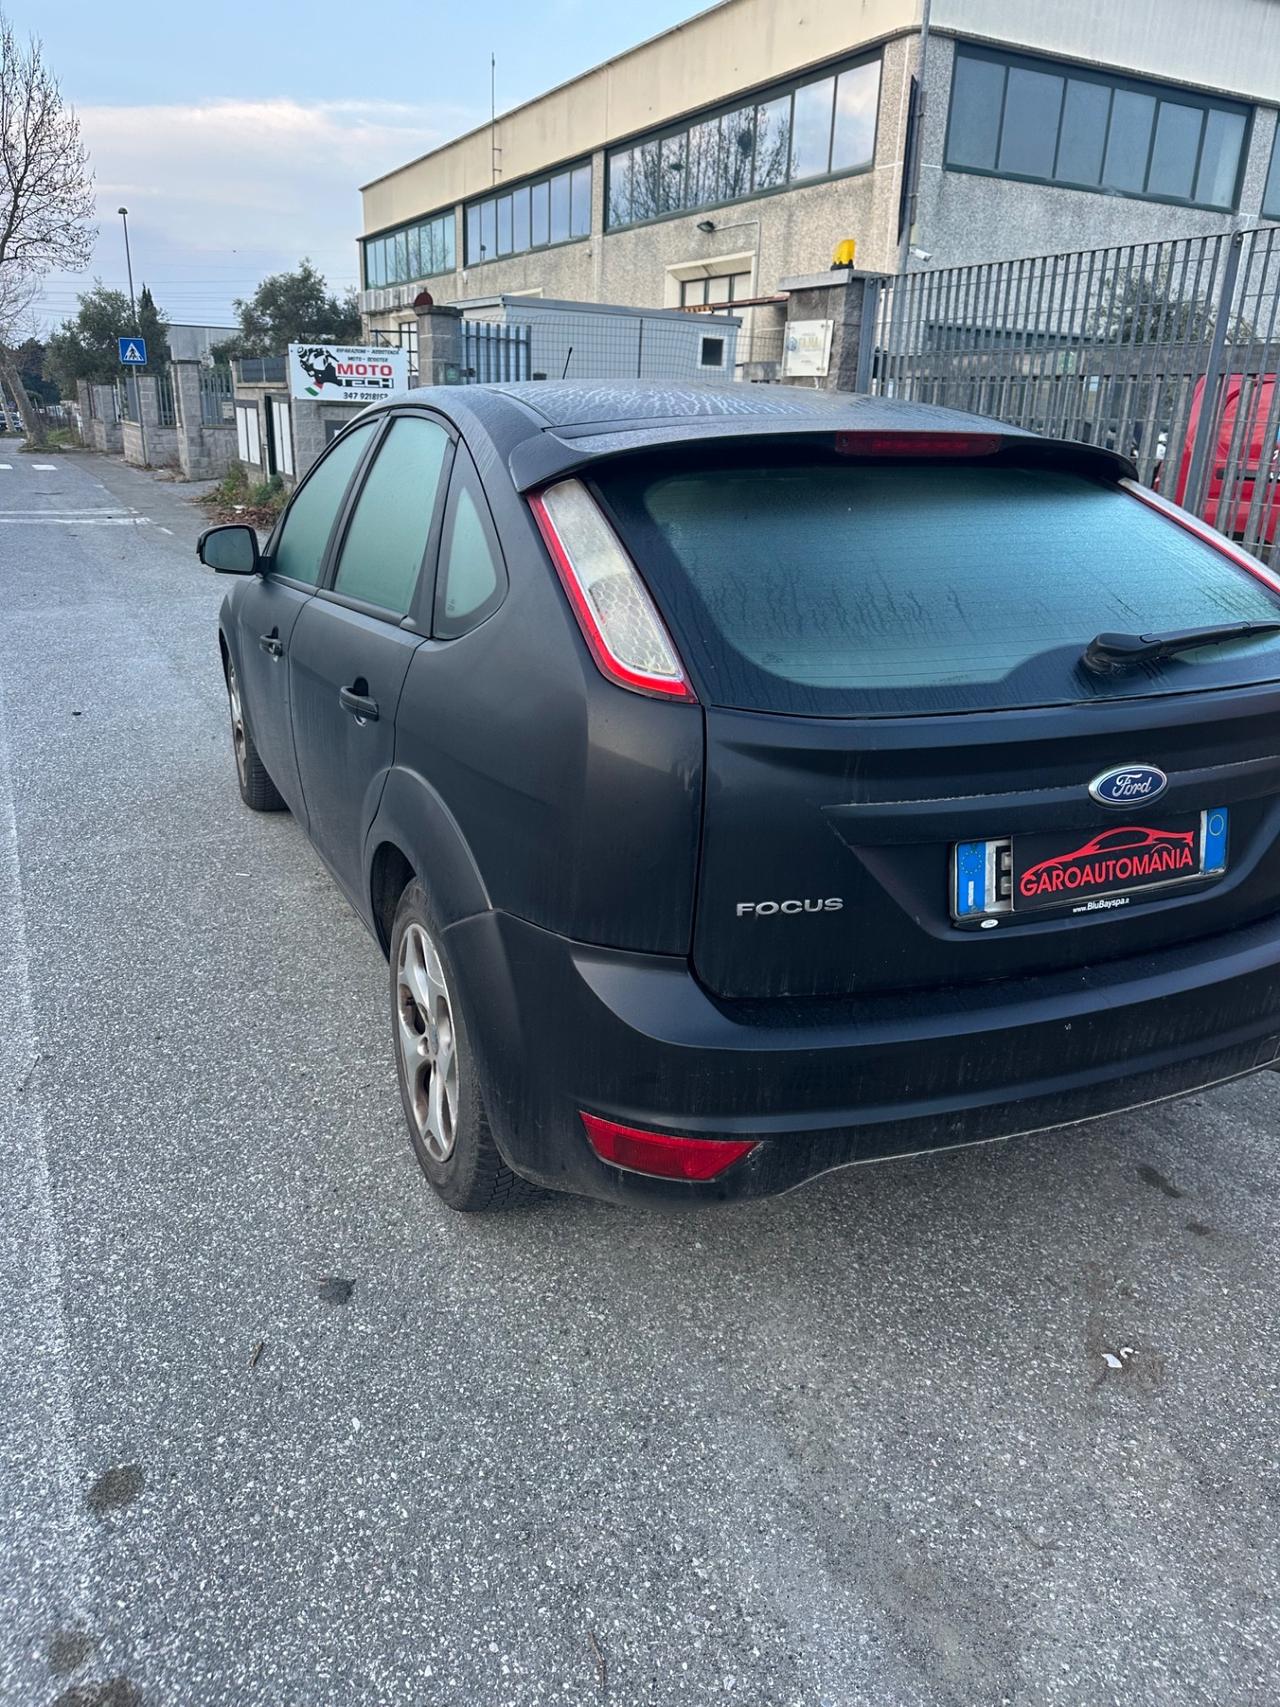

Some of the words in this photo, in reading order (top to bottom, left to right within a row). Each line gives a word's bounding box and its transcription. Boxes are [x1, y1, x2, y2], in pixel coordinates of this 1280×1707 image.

[337, 364, 393, 376] MOTO
[343, 391, 358, 400] 347
[1112, 772, 1152, 797] Ford
[1020, 847, 1193, 896] GAROAUTOMANIA
[736, 898, 844, 916] FOCUS
